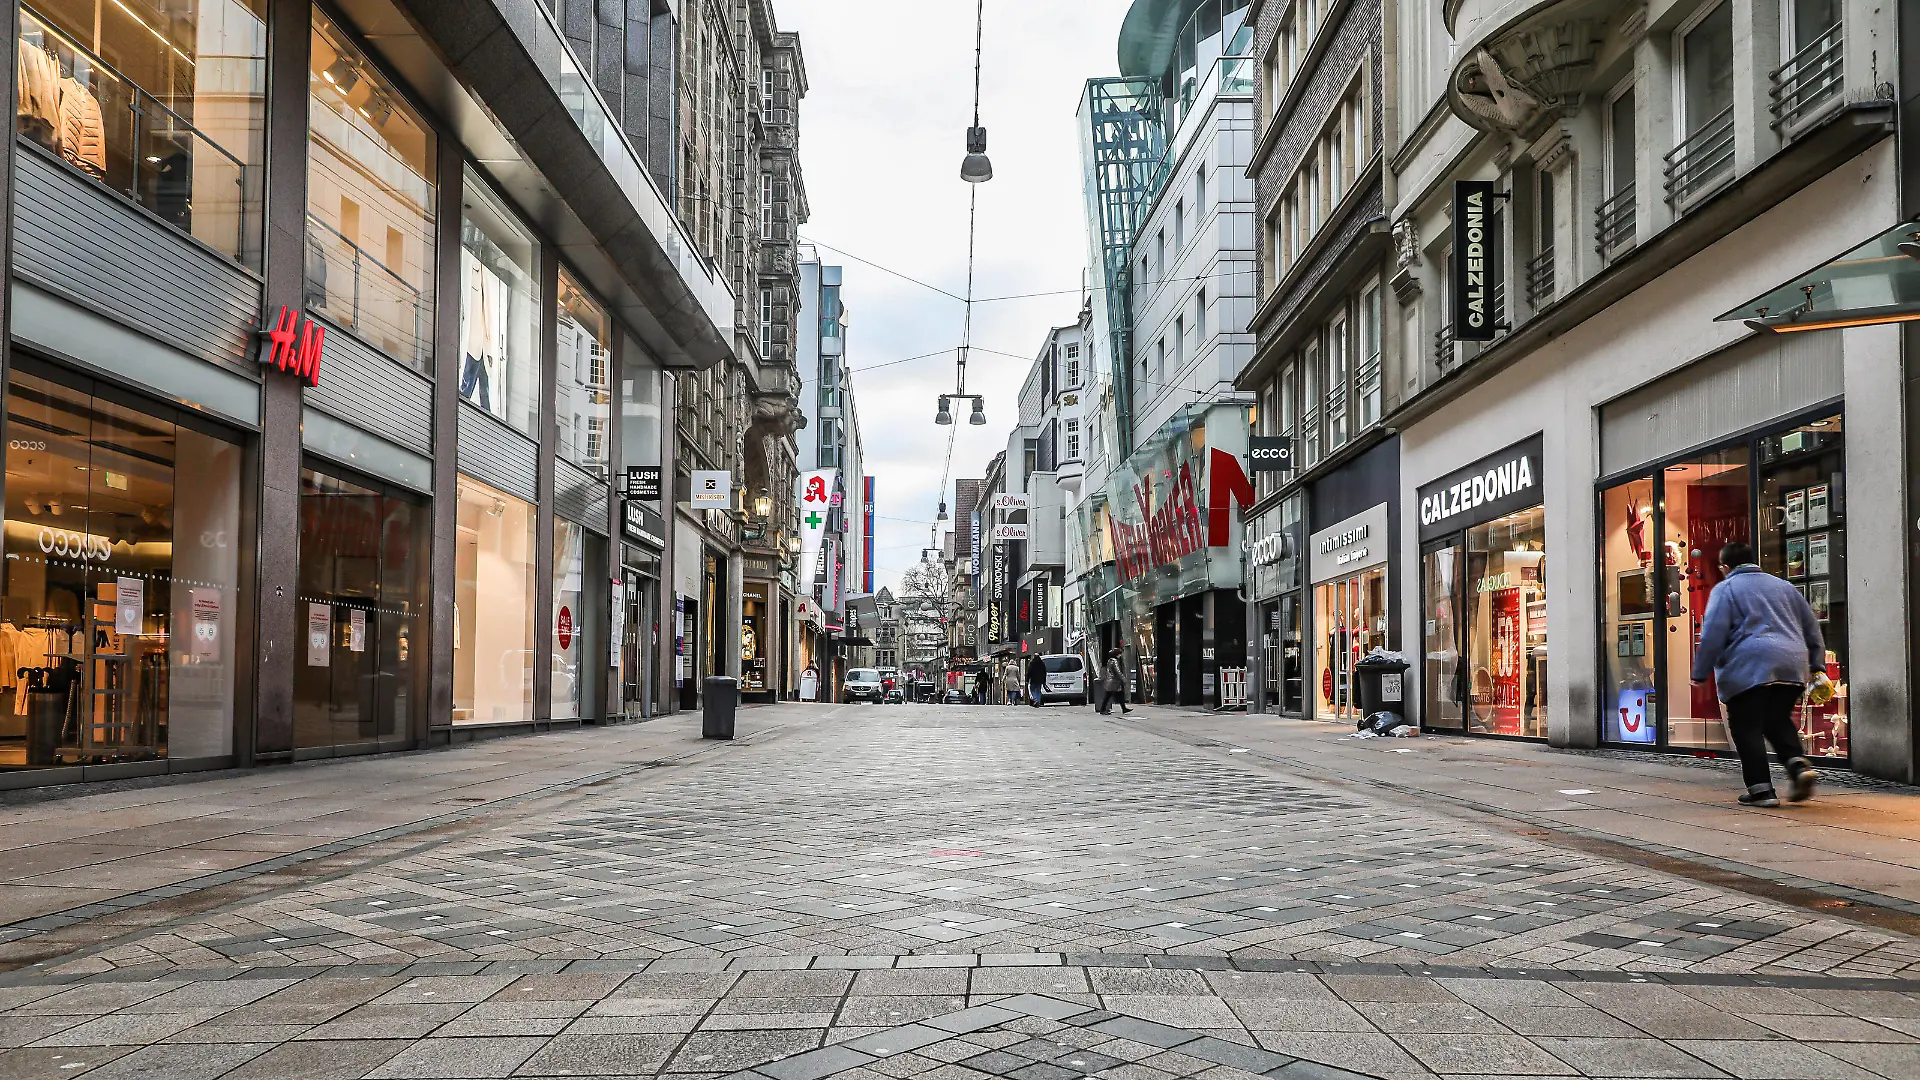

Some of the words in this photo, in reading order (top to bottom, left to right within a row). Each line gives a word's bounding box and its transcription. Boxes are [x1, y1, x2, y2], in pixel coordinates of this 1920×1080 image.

[1467, 190, 1485, 329] CALZEDONIA
[269, 305, 325, 387] H&M
[1251, 448, 1289, 459] ecco
[629, 471, 659, 480] LUSH
[1420, 454, 1534, 527] CALZEDONIA
[627, 504, 644, 527] LUSH
[996, 495, 1026, 507] s.Oliver
[972, 520, 980, 576] WORMLAND
[996, 526, 1026, 537] s.Oliver
[1319, 524, 1369, 555] intimissimi
[1252, 533, 1282, 567] ecco
[994, 555, 1003, 599] SWAROVSKI
[988, 602, 999, 641] Pieper
